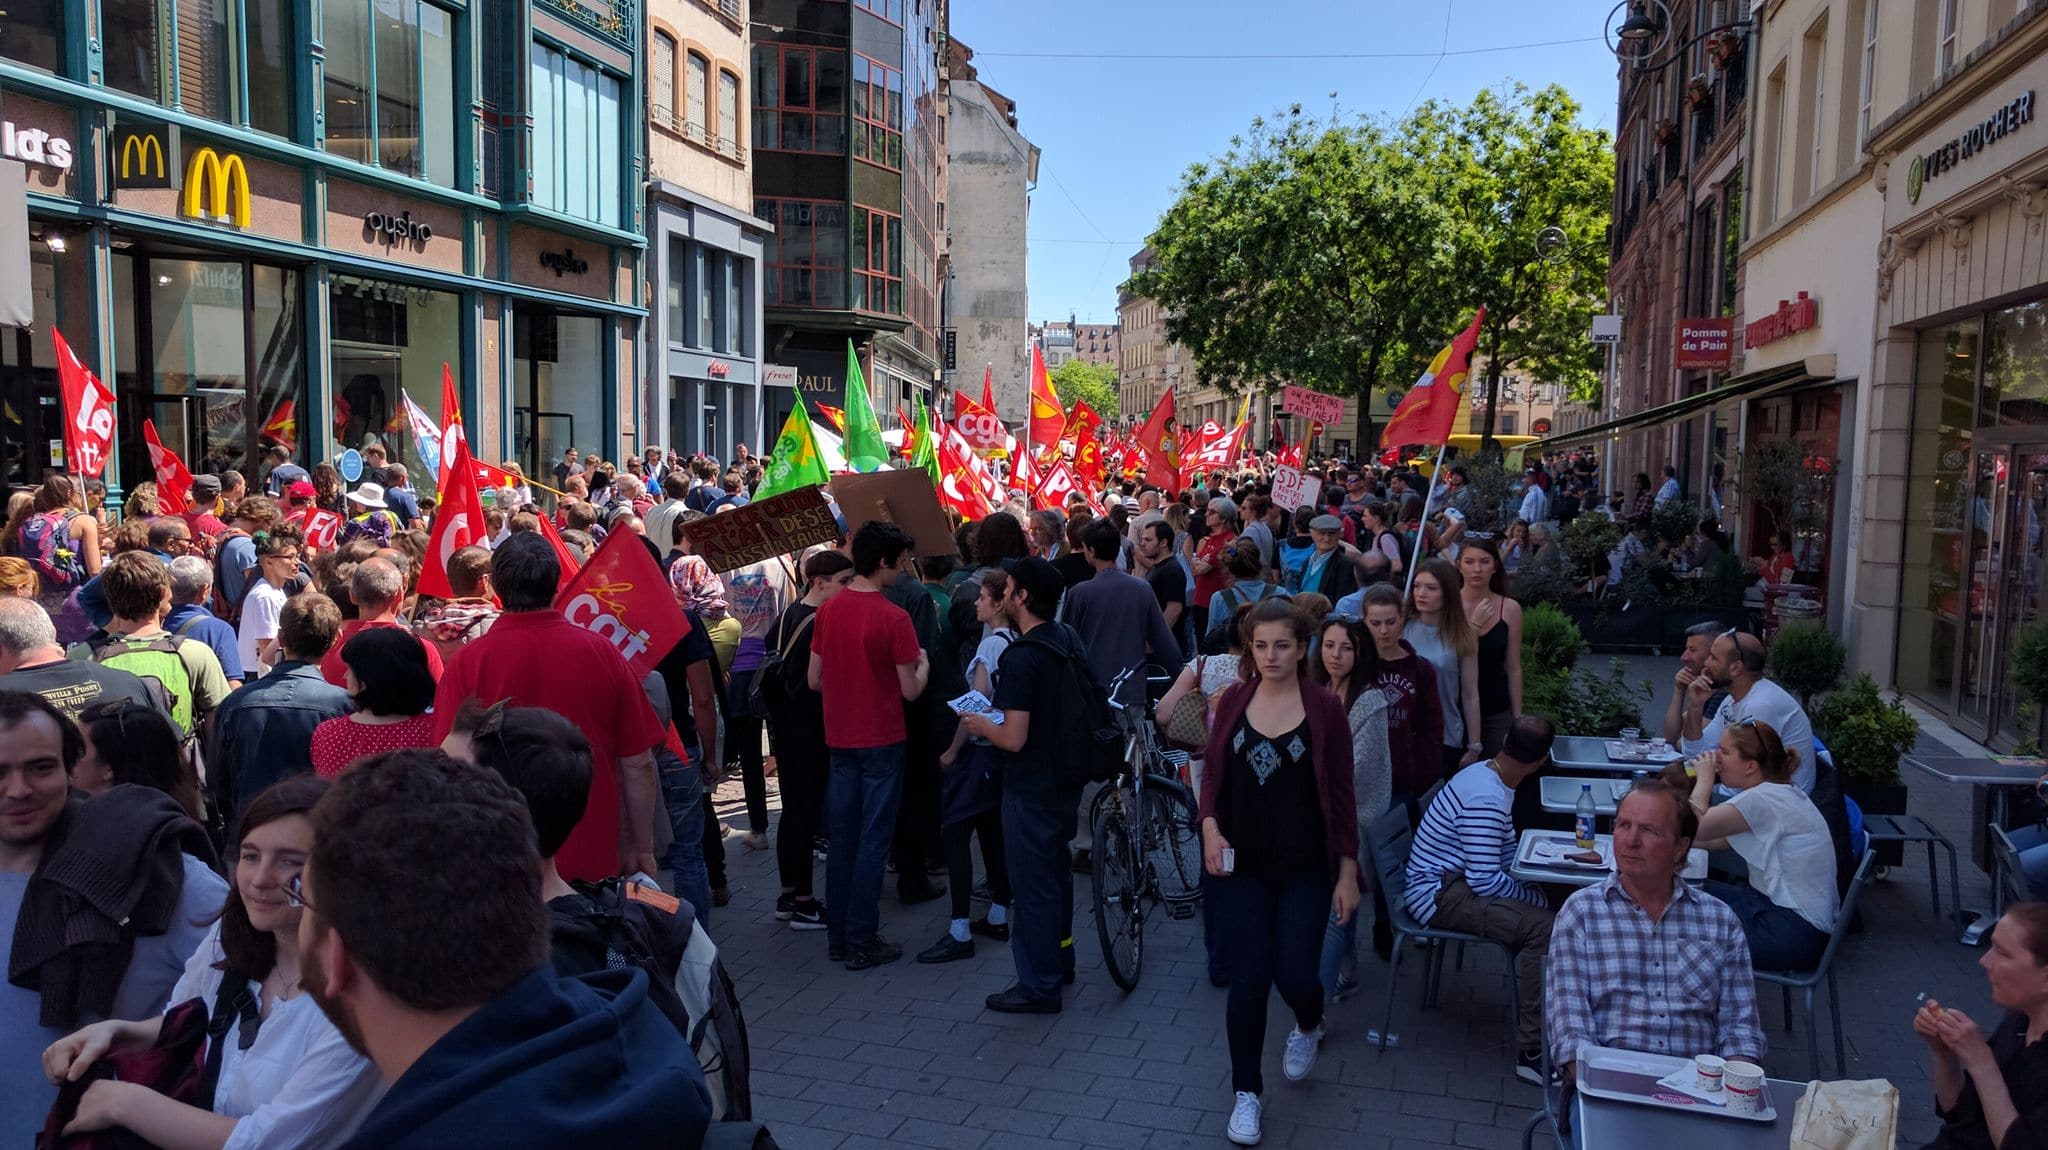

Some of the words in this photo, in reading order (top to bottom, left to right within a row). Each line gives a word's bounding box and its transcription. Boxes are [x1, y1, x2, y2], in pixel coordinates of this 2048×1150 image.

[1924, 138, 1960, 182] YVES
[1961, 90, 2035, 160] ROCHER
[366, 211, 433, 244] oysho
[1682, 328, 1728, 338] Pomme
[1682, 340, 1697, 350] de
[1700, 340, 1728, 350] Pain
[708, 357, 731, 379] free
[766, 370, 793, 381] free
[1291, 390, 1302, 399] ON
[1276, 468, 1306, 490] SDF
[1273, 490, 1288, 504] CHEZ
[687, 506, 764, 544] EST-CE
[787, 524, 837, 549] FAIRE
